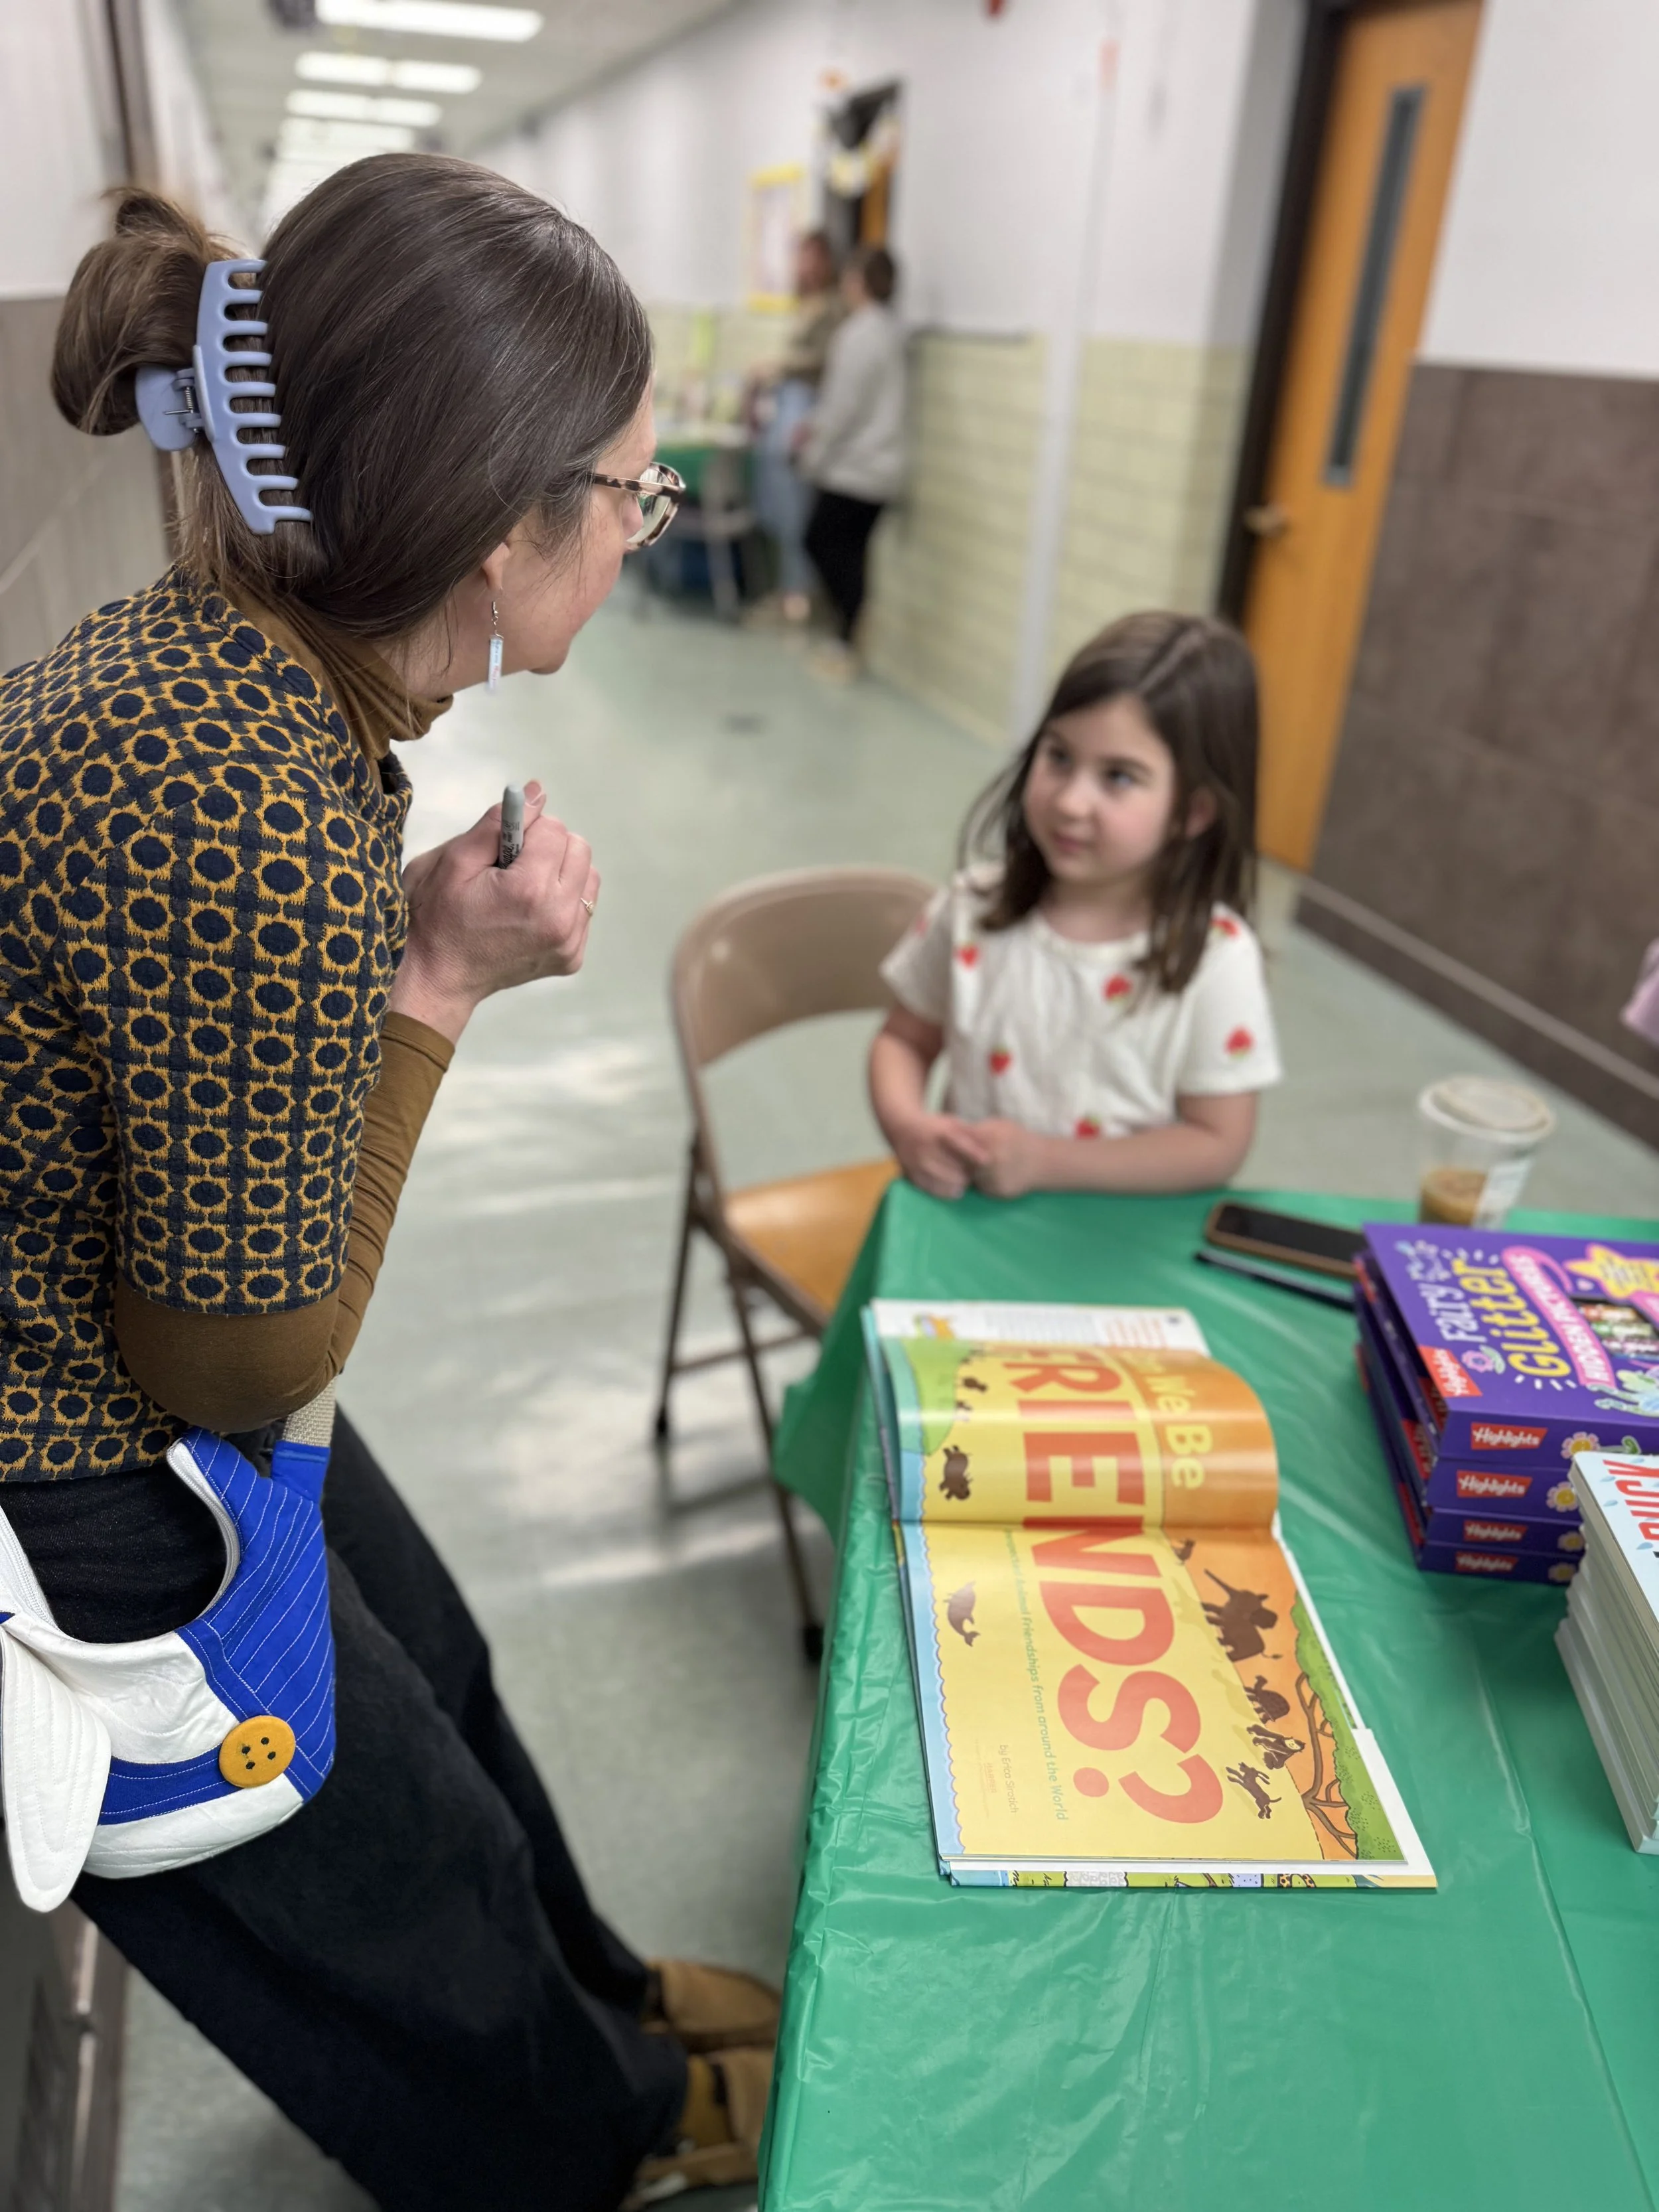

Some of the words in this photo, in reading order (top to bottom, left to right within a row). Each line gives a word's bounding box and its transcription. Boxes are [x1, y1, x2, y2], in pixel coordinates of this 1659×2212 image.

[1452, 1258, 1571, 1377] Glitter
[1559, 1323, 1610, 1382] HIDDEN
[1433, 1348, 1471, 1396] Highlights
[1472, 1426, 1541, 1448] Highlights
[1166, 1425, 1213, 1489] Be
[1458, 1475, 1526, 1497] Highlights
[1465, 1524, 1522, 1541] Highlights
[1457, 1554, 1514, 1572] Highlights
[1022, 1616, 1040, 1682] Friendships
[1033, 1683, 1045, 1713] from
[998, 1745, 1009, 1756] by
[1039, 1716, 1056, 1759] around
[1001, 1757, 1013, 1779] Erica
[1046, 1761, 1059, 1782] the
[1050, 1785, 1069, 1820] World
